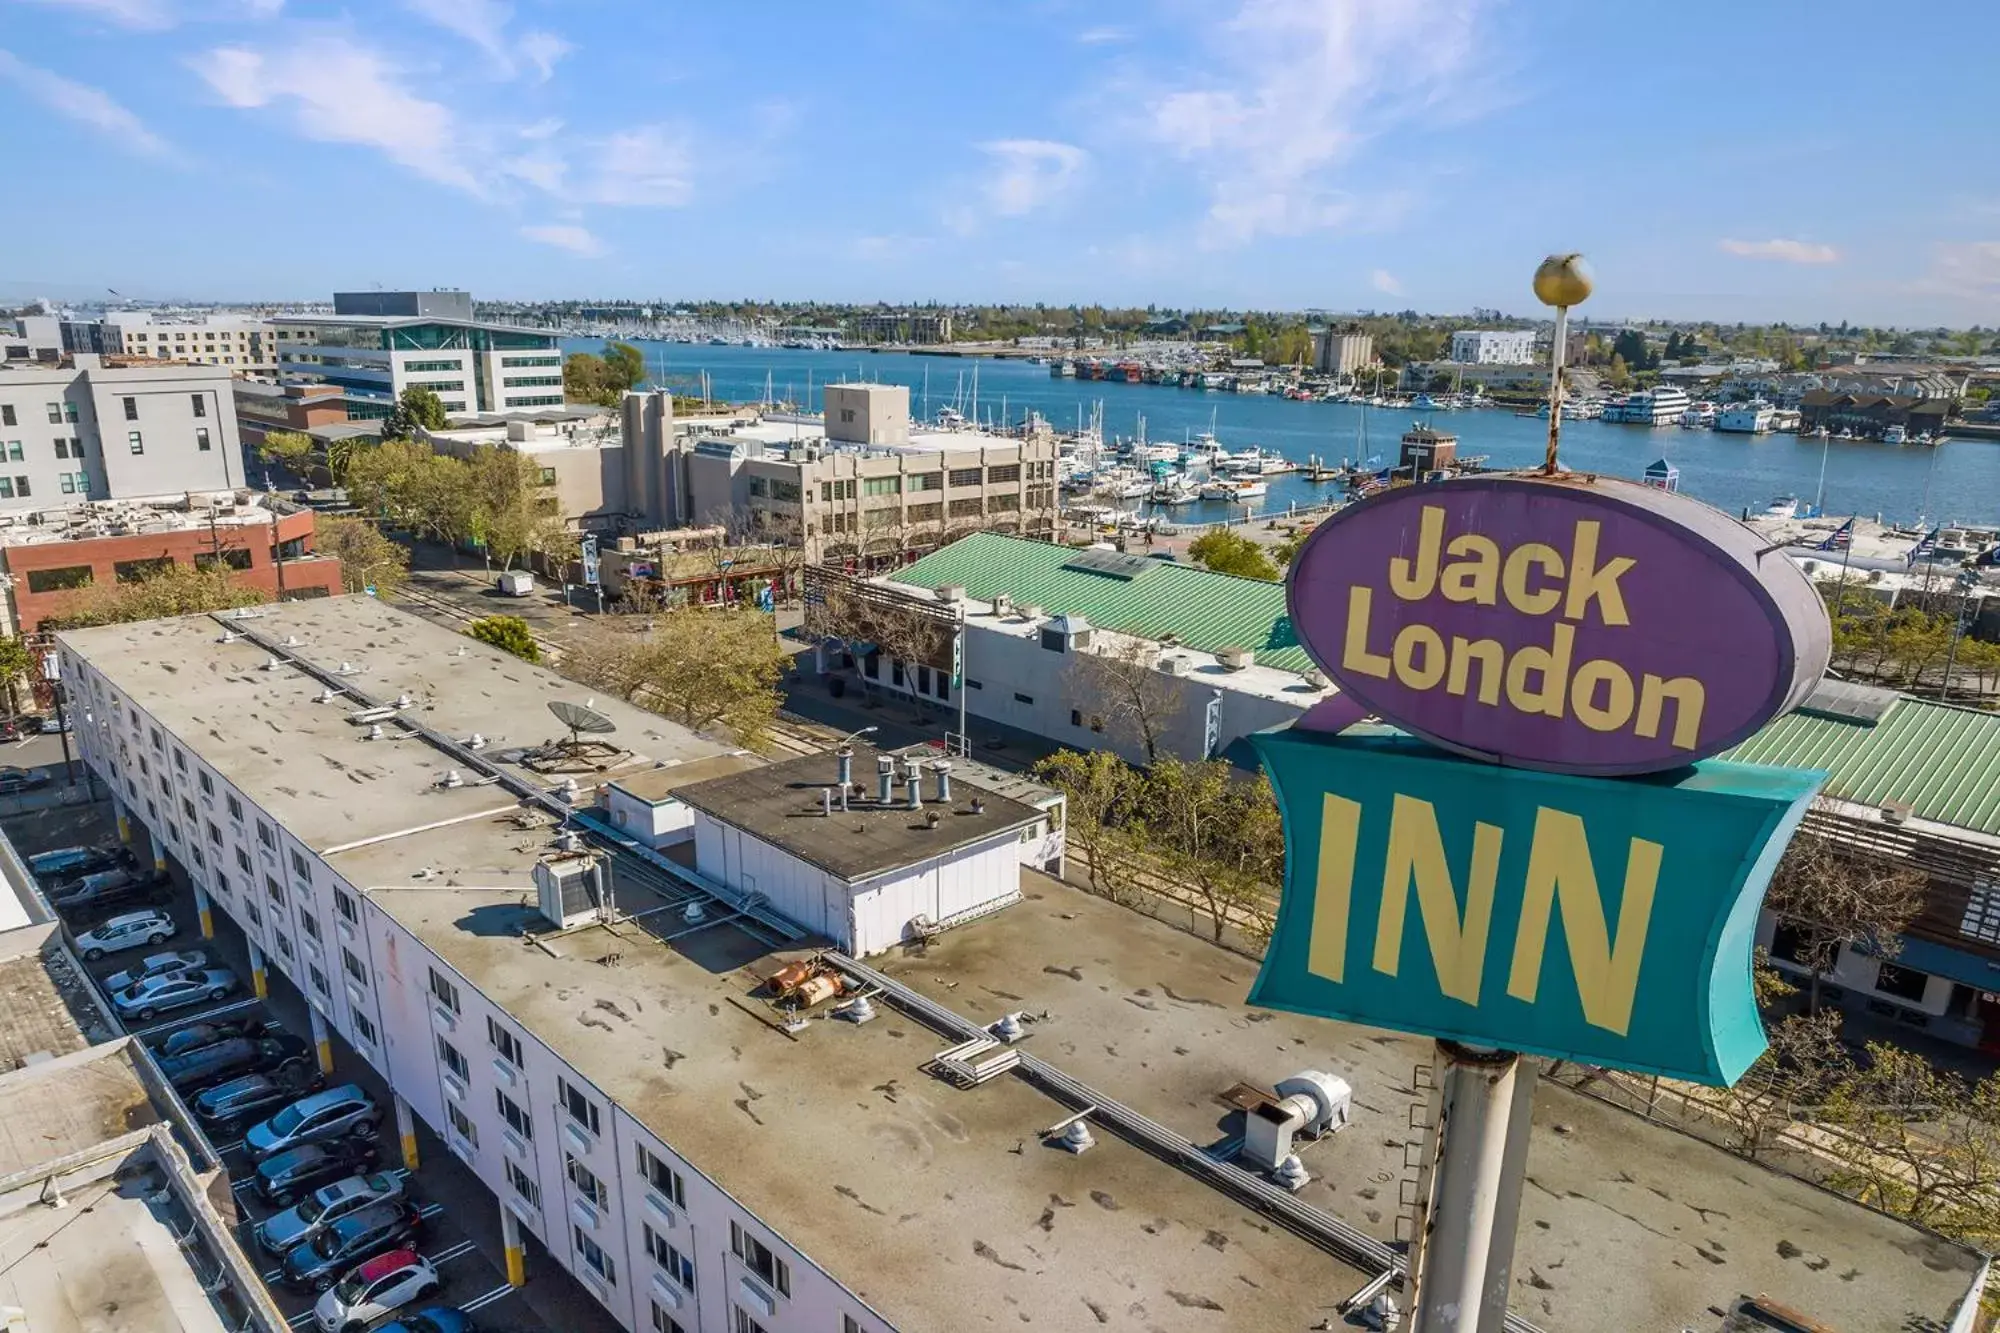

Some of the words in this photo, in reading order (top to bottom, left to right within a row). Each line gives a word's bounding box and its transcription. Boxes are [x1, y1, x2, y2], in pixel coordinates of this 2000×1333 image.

[1389, 505, 1636, 625] Jack
[1343, 585, 1705, 749] London
[1307, 792, 1664, 1037] INN
